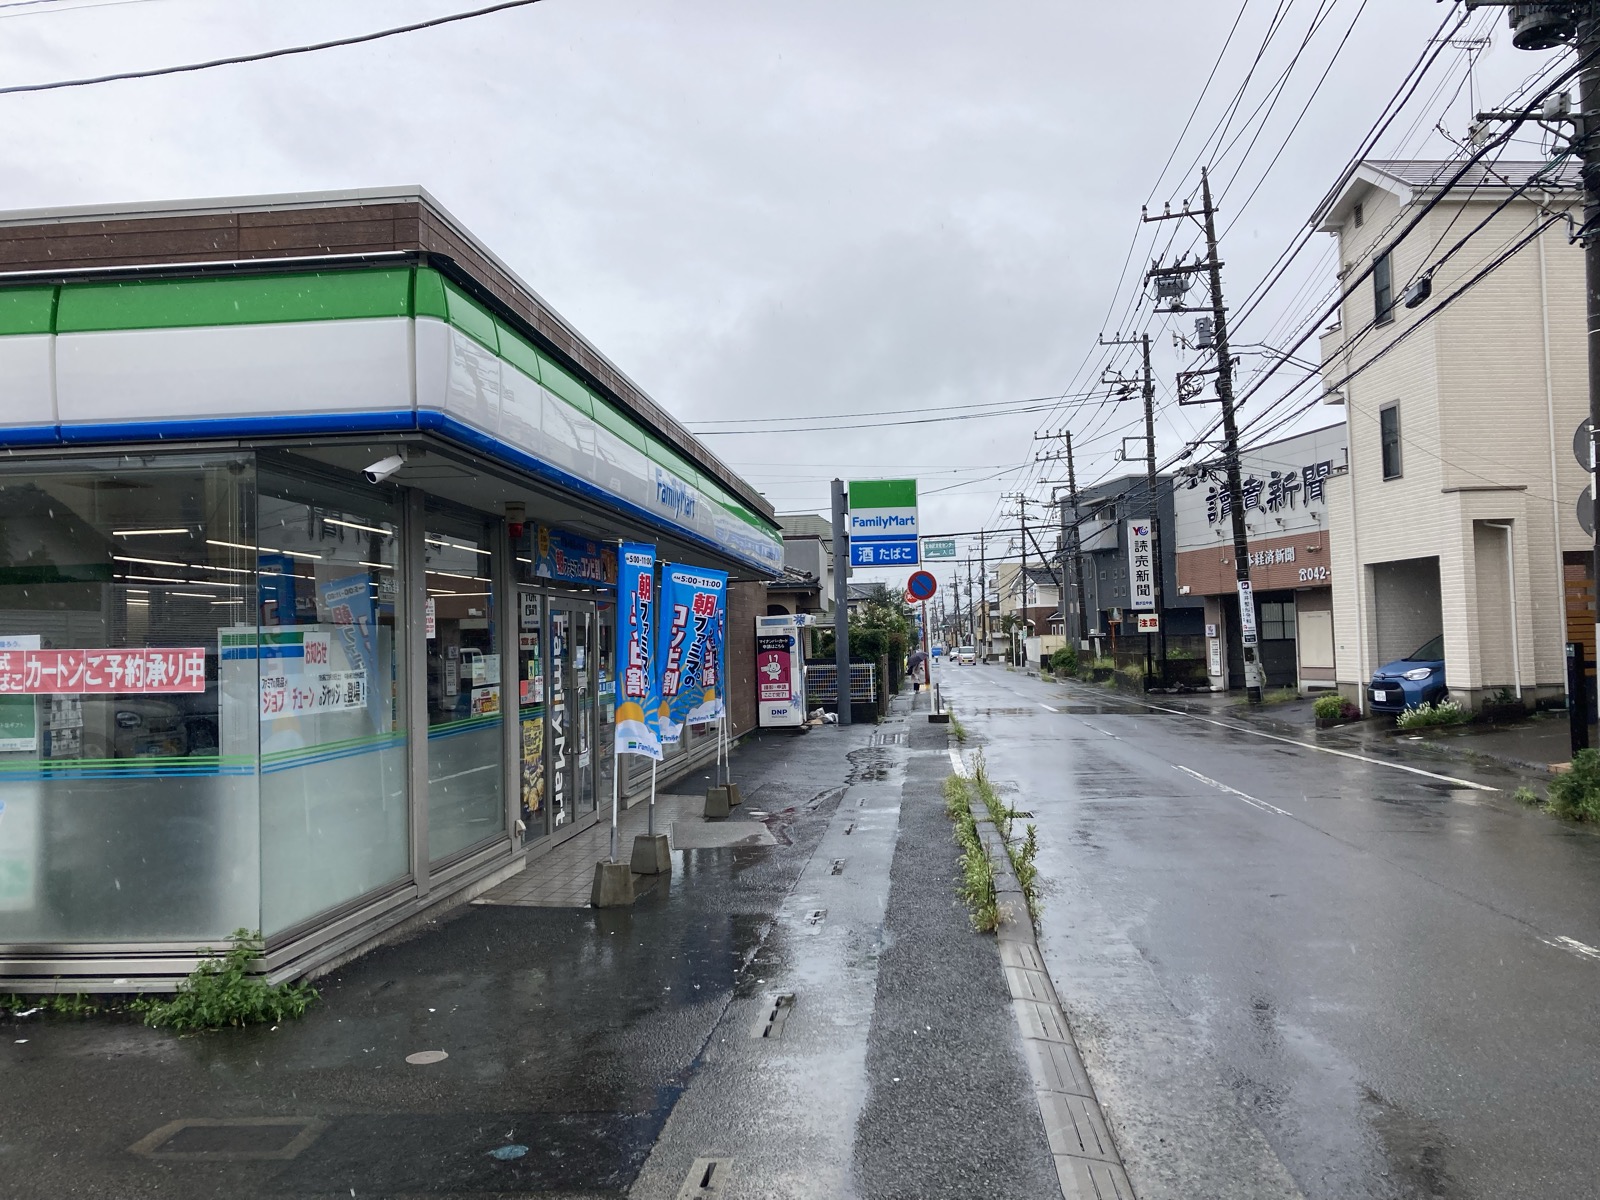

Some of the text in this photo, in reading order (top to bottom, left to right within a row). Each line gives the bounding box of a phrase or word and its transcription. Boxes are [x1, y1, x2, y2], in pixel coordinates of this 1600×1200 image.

[656, 467, 696, 519] FamilyMart
[852, 515, 915, 529] FamilyMart
[858, 547, 912, 562] 酒 たばこ
[1244, 546, 1296, 567] 本経済新聞
[1134, 540, 1151, 596] 読売新聞
[680, 575, 721, 588] 5:00-11:00
[1139, 618, 1158, 628] 注意
[305, 642, 327, 664] お知らせ
[663, 604, 689, 696] コンビ割
[552, 614, 566, 826] FamilyMart
